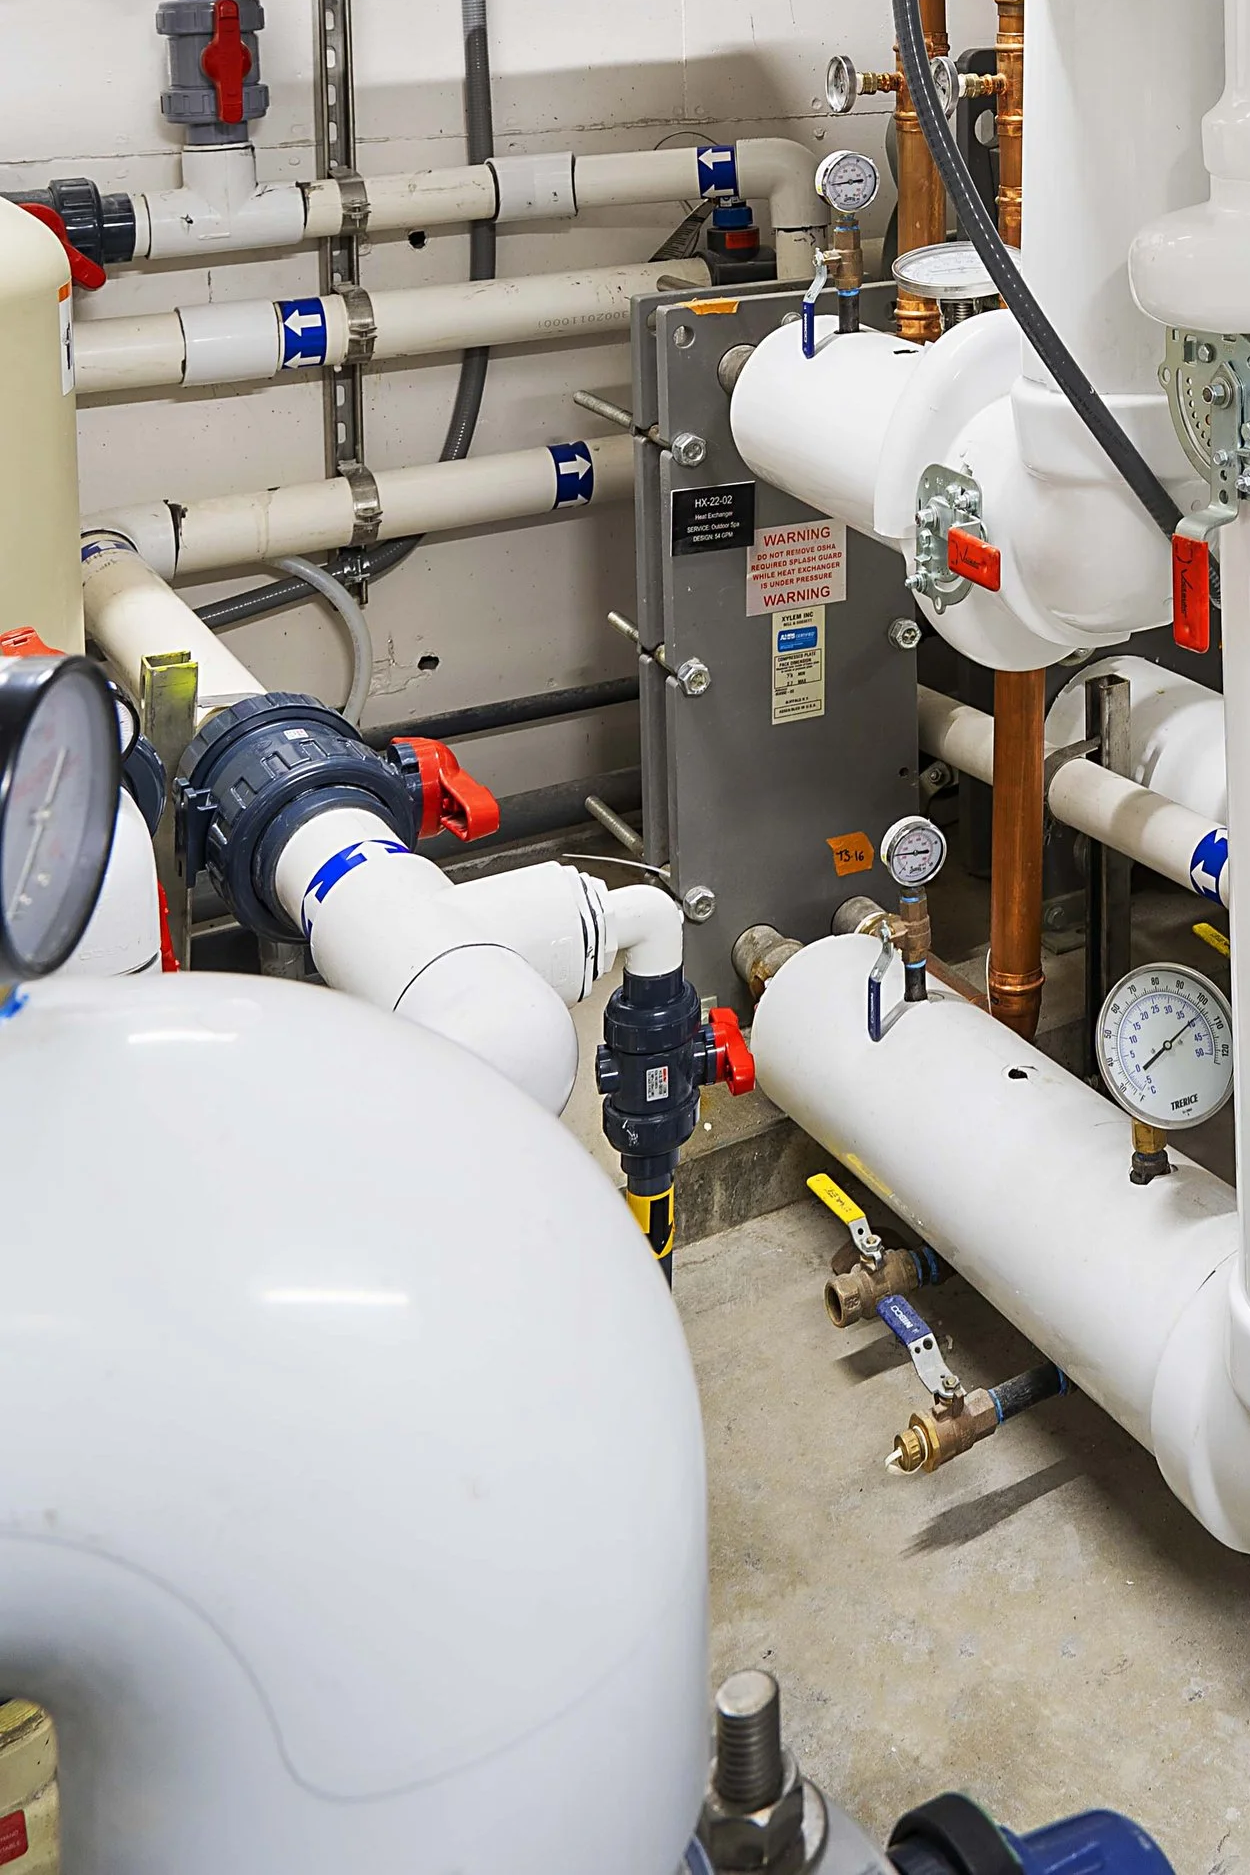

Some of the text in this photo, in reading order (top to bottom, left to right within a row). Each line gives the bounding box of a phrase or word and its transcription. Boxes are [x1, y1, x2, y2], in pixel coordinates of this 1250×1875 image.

[694, 495, 733, 508] HX-22-02
[694, 511, 734, 521] Heat Exchanger
[721, 531, 734, 540] GPM
[764, 526, 831, 547] WARNING
[757, 543, 836, 561] DO NOT REMOVE OSHA
[751, 551, 842, 572] REQUIRED SPLASH GUARD
[752, 561, 841, 581] WHILE HEAT EXCHANGER
[760, 572, 833, 589] IS UNDER PRESSURE
[763, 585, 831, 607] WARNING
[781, 612, 802, 623] XYLEM
[1150, 976, 1160, 986] 80
[1175, 979, 1185, 990] 90
[1127, 984, 1137, 994] 70
[1196, 992, 1209, 1006] 100
[1110, 1003, 1121, 1014] 60
[1151, 1005, 1160, 1014] 25
[1164, 1005, 1173, 1014] 30
[1140, 1011, 1149, 1021] 20
[1175, 1010, 1185, 1021] 35
[1132, 1022, 1141, 1032] 15
[1213, 1016, 1224, 1030] 110
[1103, 1029, 1112, 1039] 50
[1128, 1034, 1138, 1044] 10
[1194, 1032, 1203, 1042] 45
[1129, 1050, 1136, 1059] 5
[1195, 1047, 1205, 1057] 50
[1221, 1043, 1230, 1057] 120
[1135, 1064, 1141, 1073] 0
[1170, 1093, 1199, 1111] TRERICE
[890, 1304, 914, 1330] NIBCO
